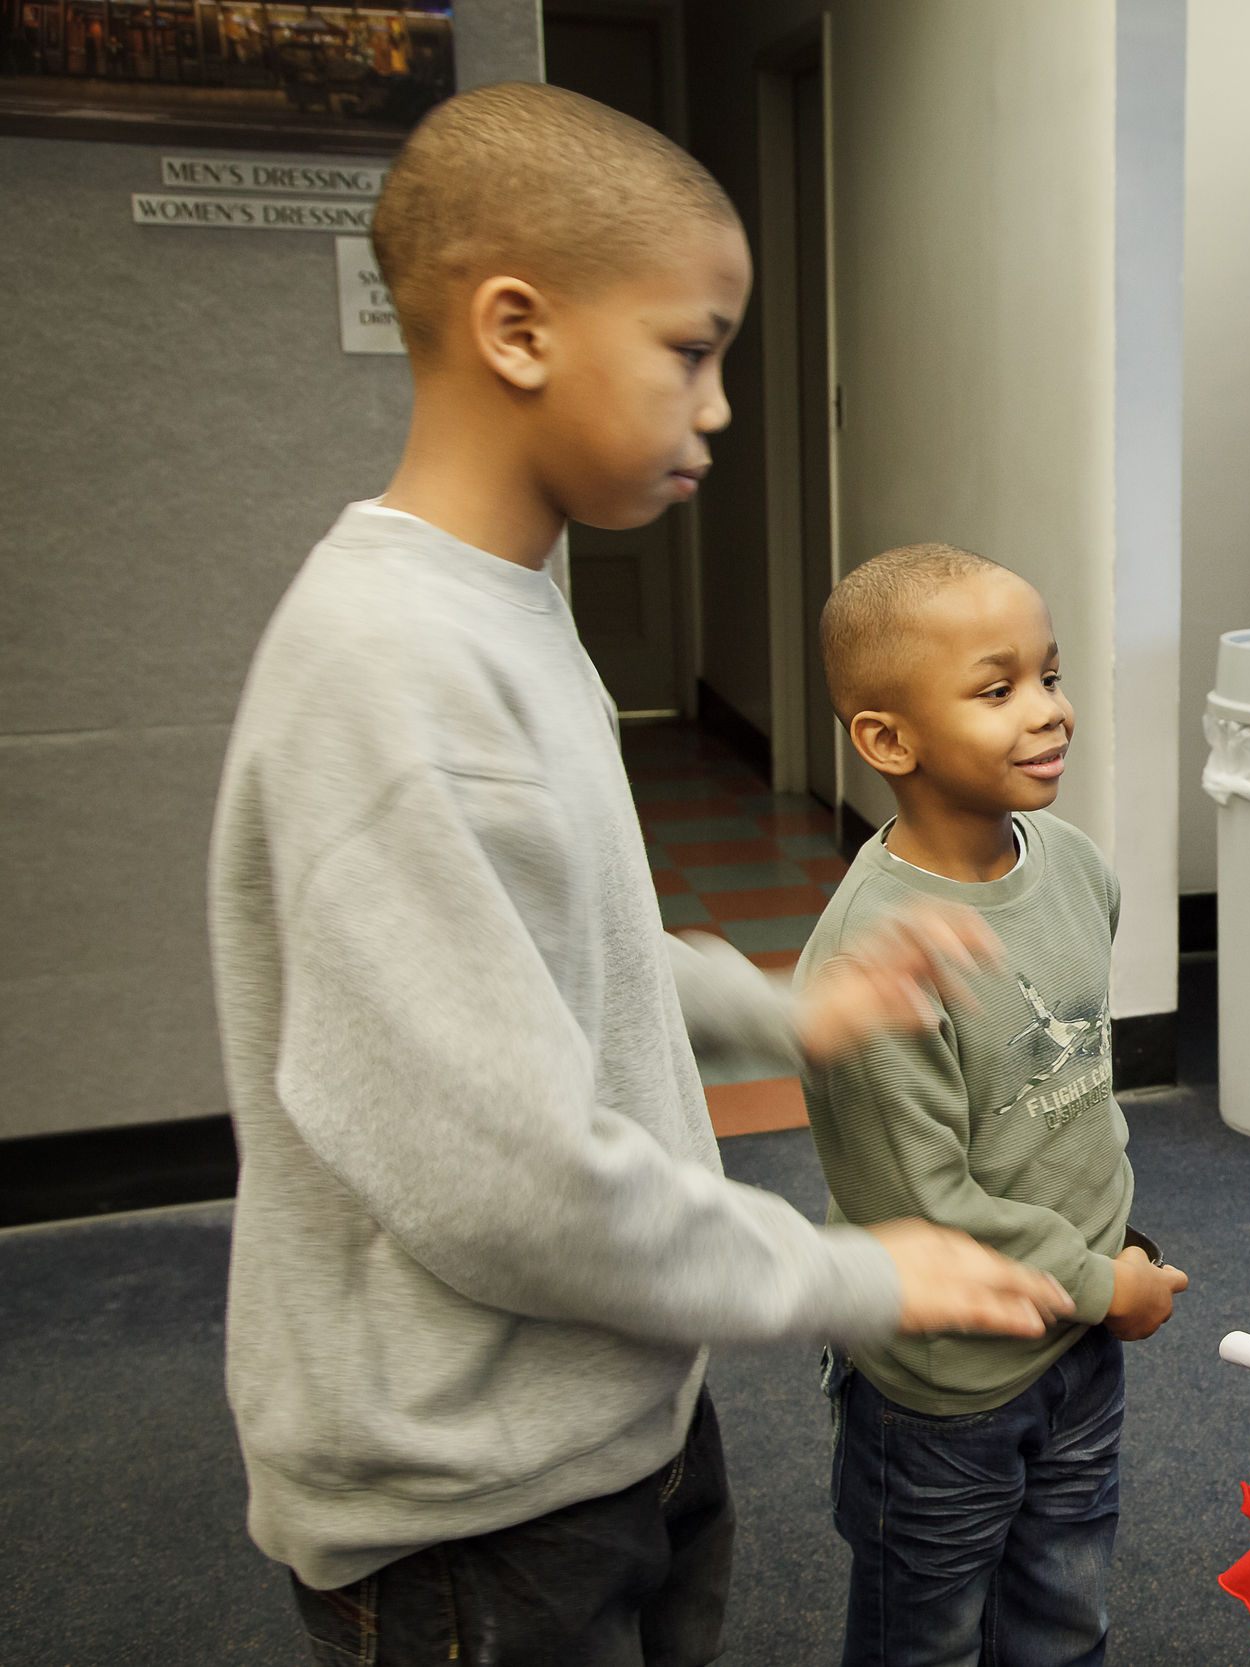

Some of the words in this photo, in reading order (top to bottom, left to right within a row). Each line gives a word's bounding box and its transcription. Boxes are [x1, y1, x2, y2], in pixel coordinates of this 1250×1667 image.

[166, 161, 244, 185] MEN'S
[252, 165, 373, 191] DRESSING
[137, 199, 254, 223] WOMEN'S
[262, 204, 373, 228] DRESSING
[1025, 1075, 1087, 1118] FLIGHT
